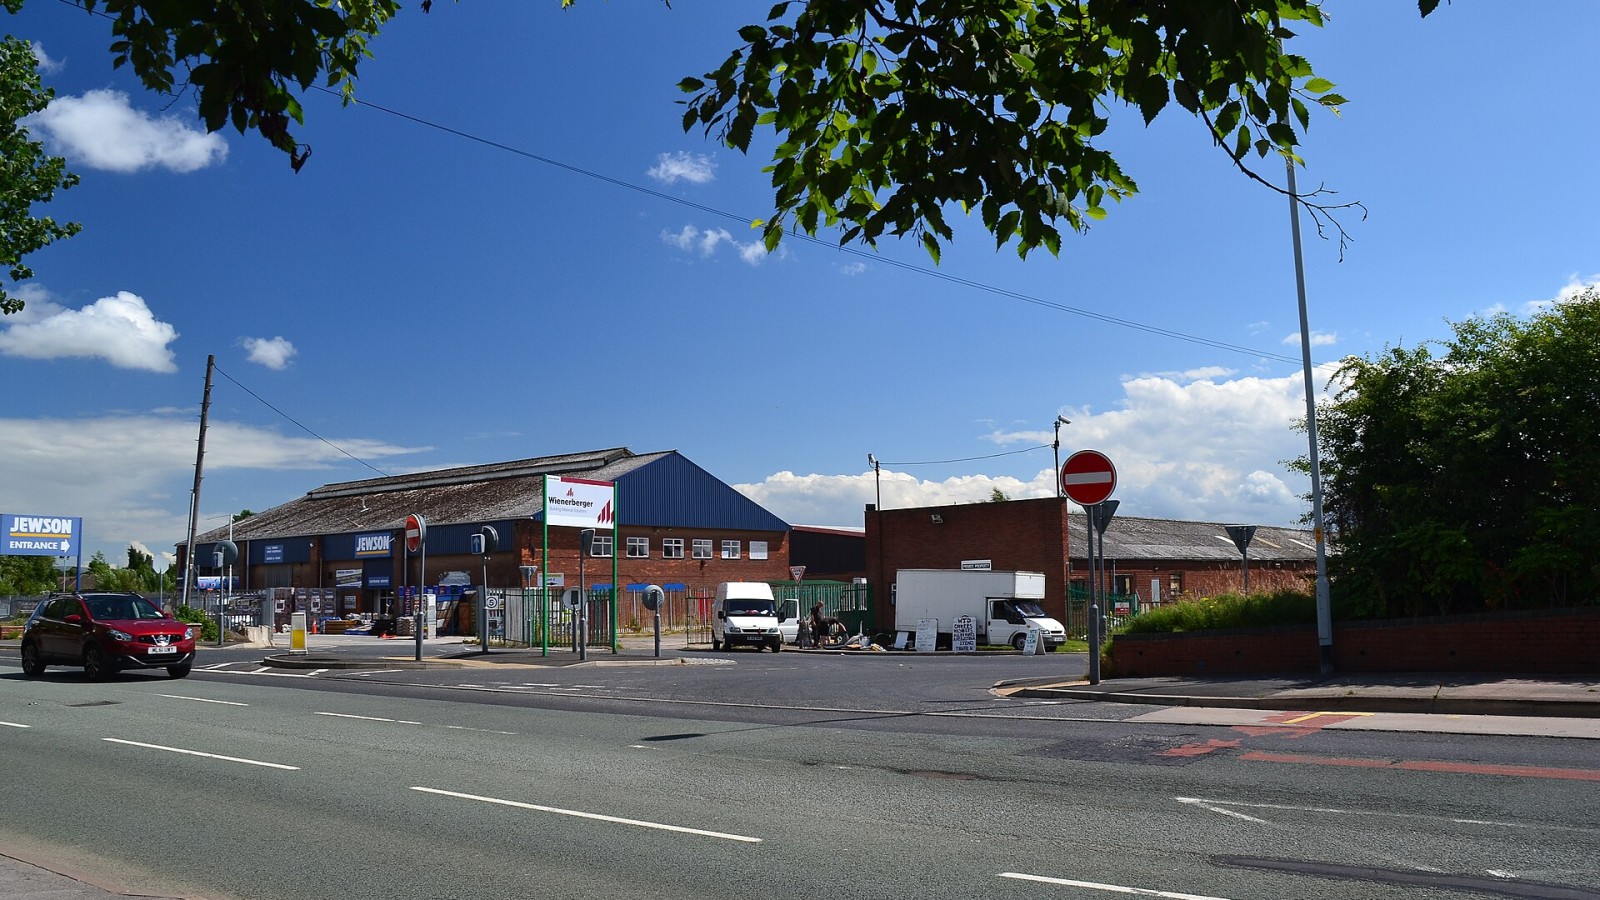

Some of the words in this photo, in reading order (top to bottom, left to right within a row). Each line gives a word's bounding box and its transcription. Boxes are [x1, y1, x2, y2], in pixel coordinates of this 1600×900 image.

[548, 496, 594, 509] Wienerberger
[10, 517, 72, 534] JEWSON
[9, 540, 58, 550] ENTRANCE
[356, 535, 390, 551] JEWSON
